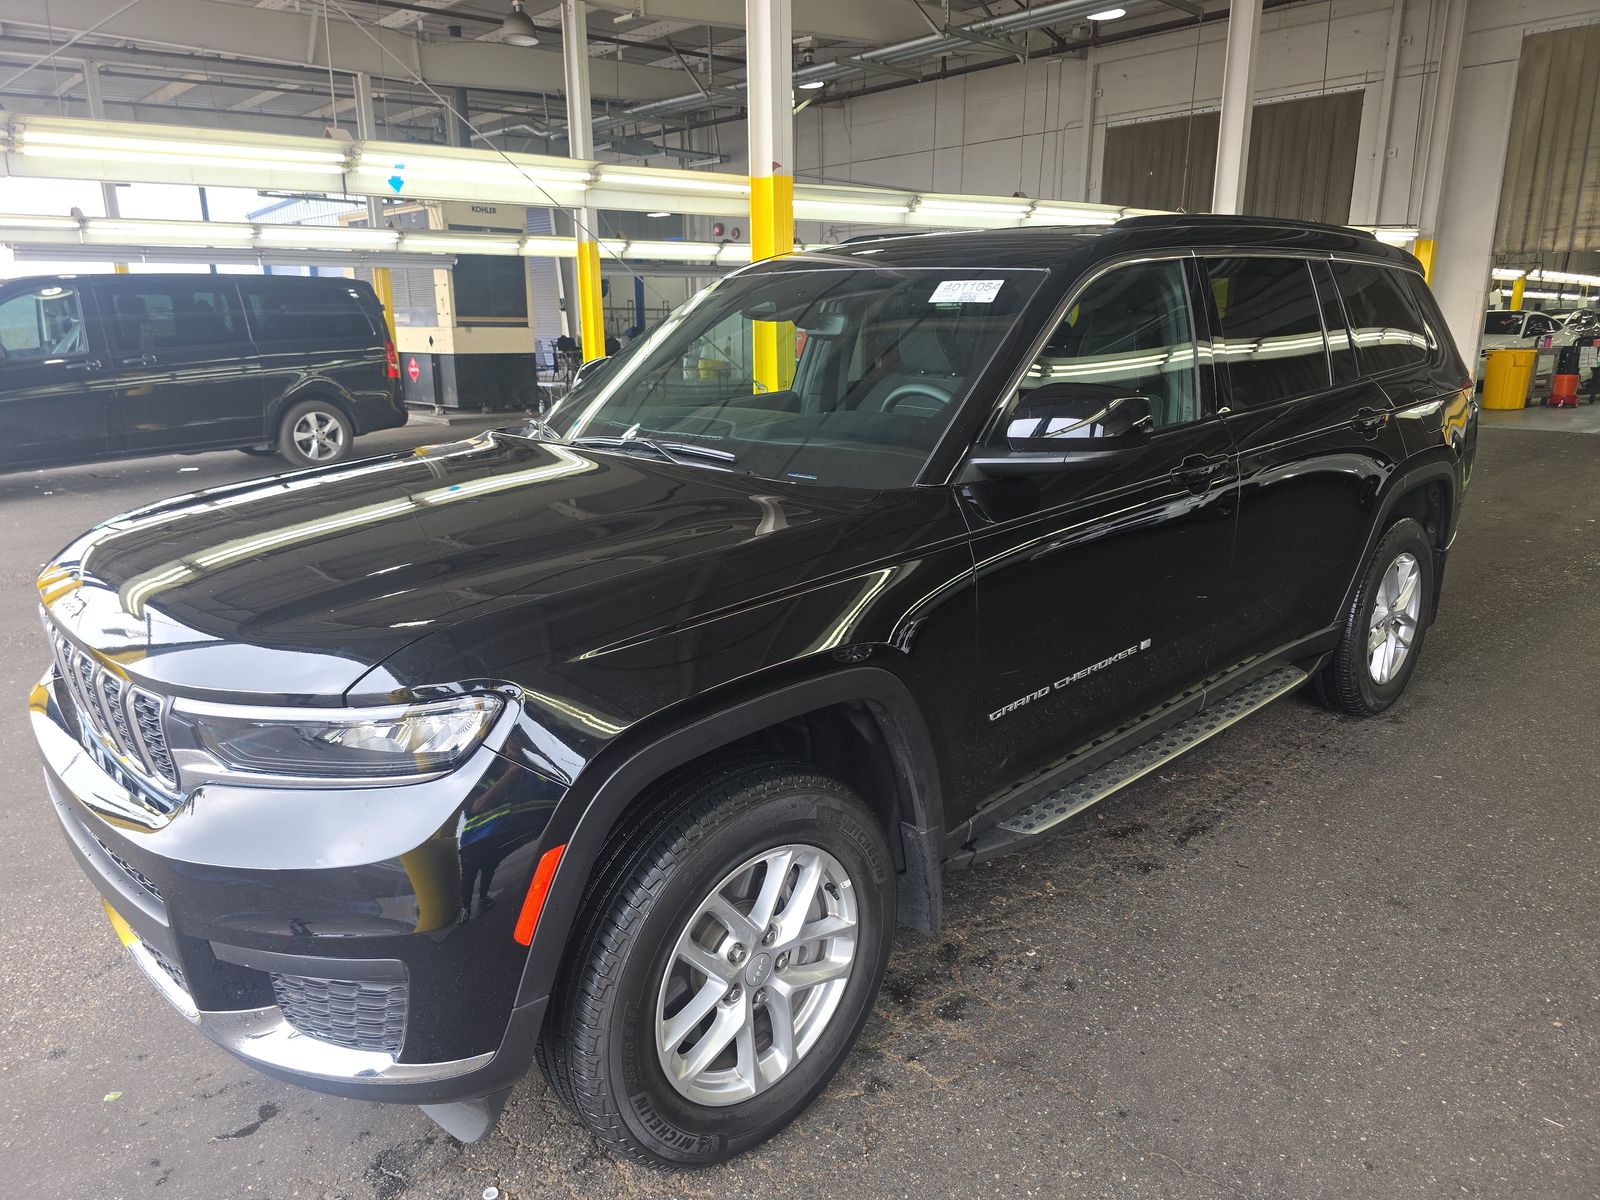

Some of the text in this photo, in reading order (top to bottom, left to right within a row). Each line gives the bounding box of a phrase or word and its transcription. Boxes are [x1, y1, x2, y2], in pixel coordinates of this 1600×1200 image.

[989, 686, 1050, 721] GRAND
[1054, 645, 1138, 689] CHEROKEE
[635, 1096, 697, 1150] MICHELIN
